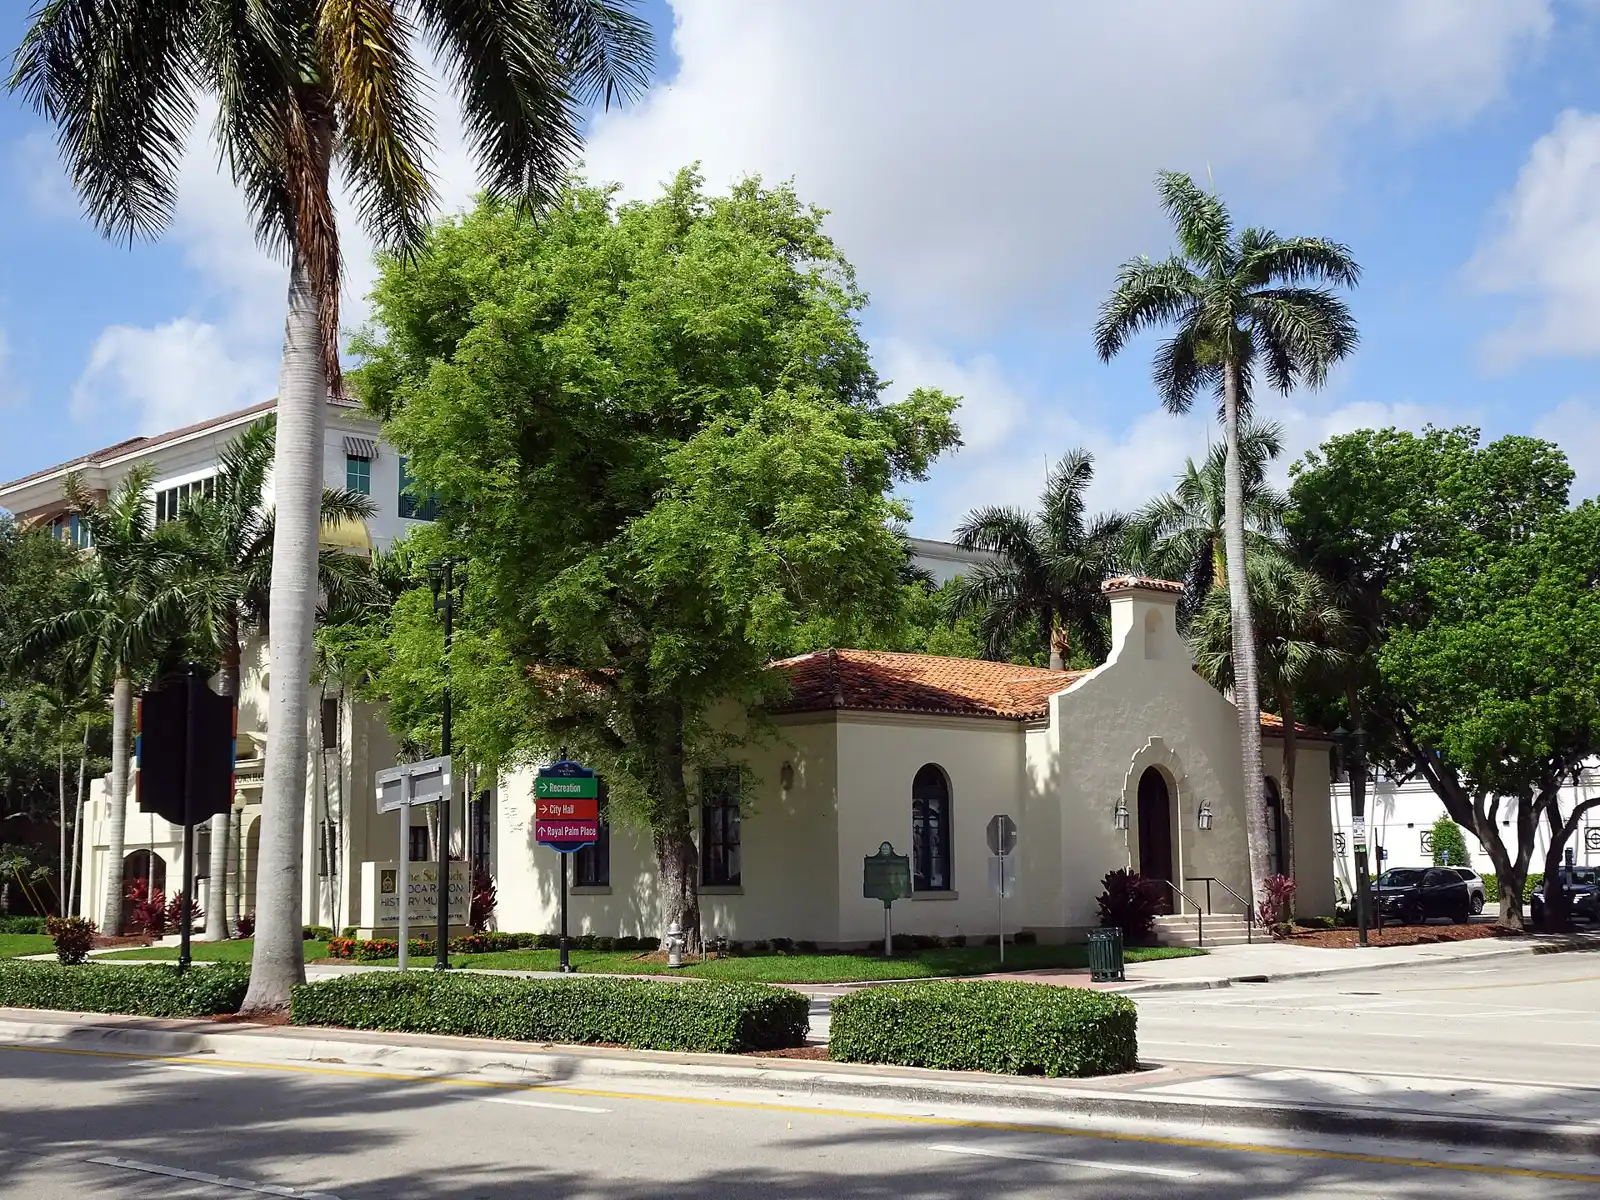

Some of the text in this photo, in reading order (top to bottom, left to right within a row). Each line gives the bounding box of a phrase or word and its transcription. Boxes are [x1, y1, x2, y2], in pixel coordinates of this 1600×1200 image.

[549, 783, 580, 793] Recreation
[549, 804, 574, 816] City Hall
[547, 826, 596, 838] Royal Palm Place
[407, 884, 427, 894] OCA
[381, 896, 463, 907] HISTRY MUUM
